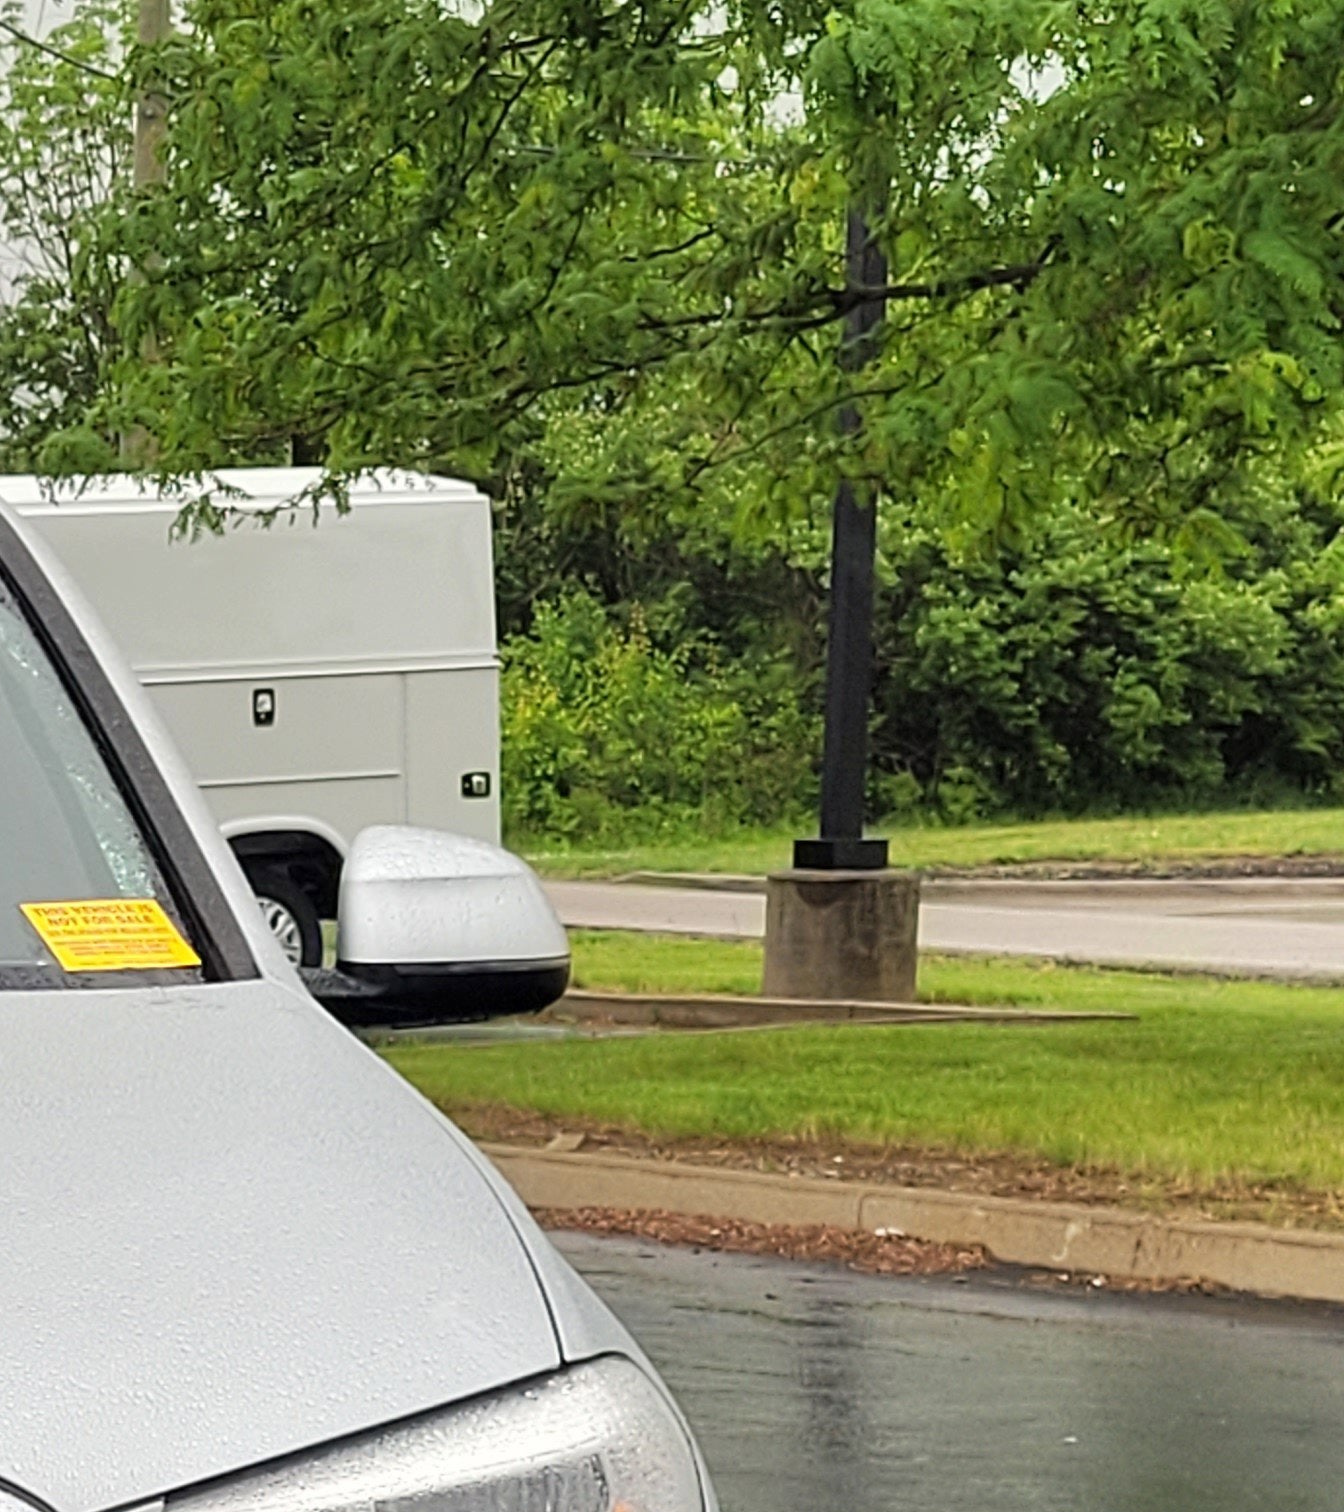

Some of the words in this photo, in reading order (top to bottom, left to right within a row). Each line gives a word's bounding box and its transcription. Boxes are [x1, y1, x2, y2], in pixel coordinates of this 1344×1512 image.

[33, 908, 69, 916] THIS
[70, 905, 135, 914] VEHICLE
[138, 904, 153, 912] IS
[48, 918, 77, 926] NOT
[82, 916, 112, 924] FOR
[115, 915, 153, 923] SALE
